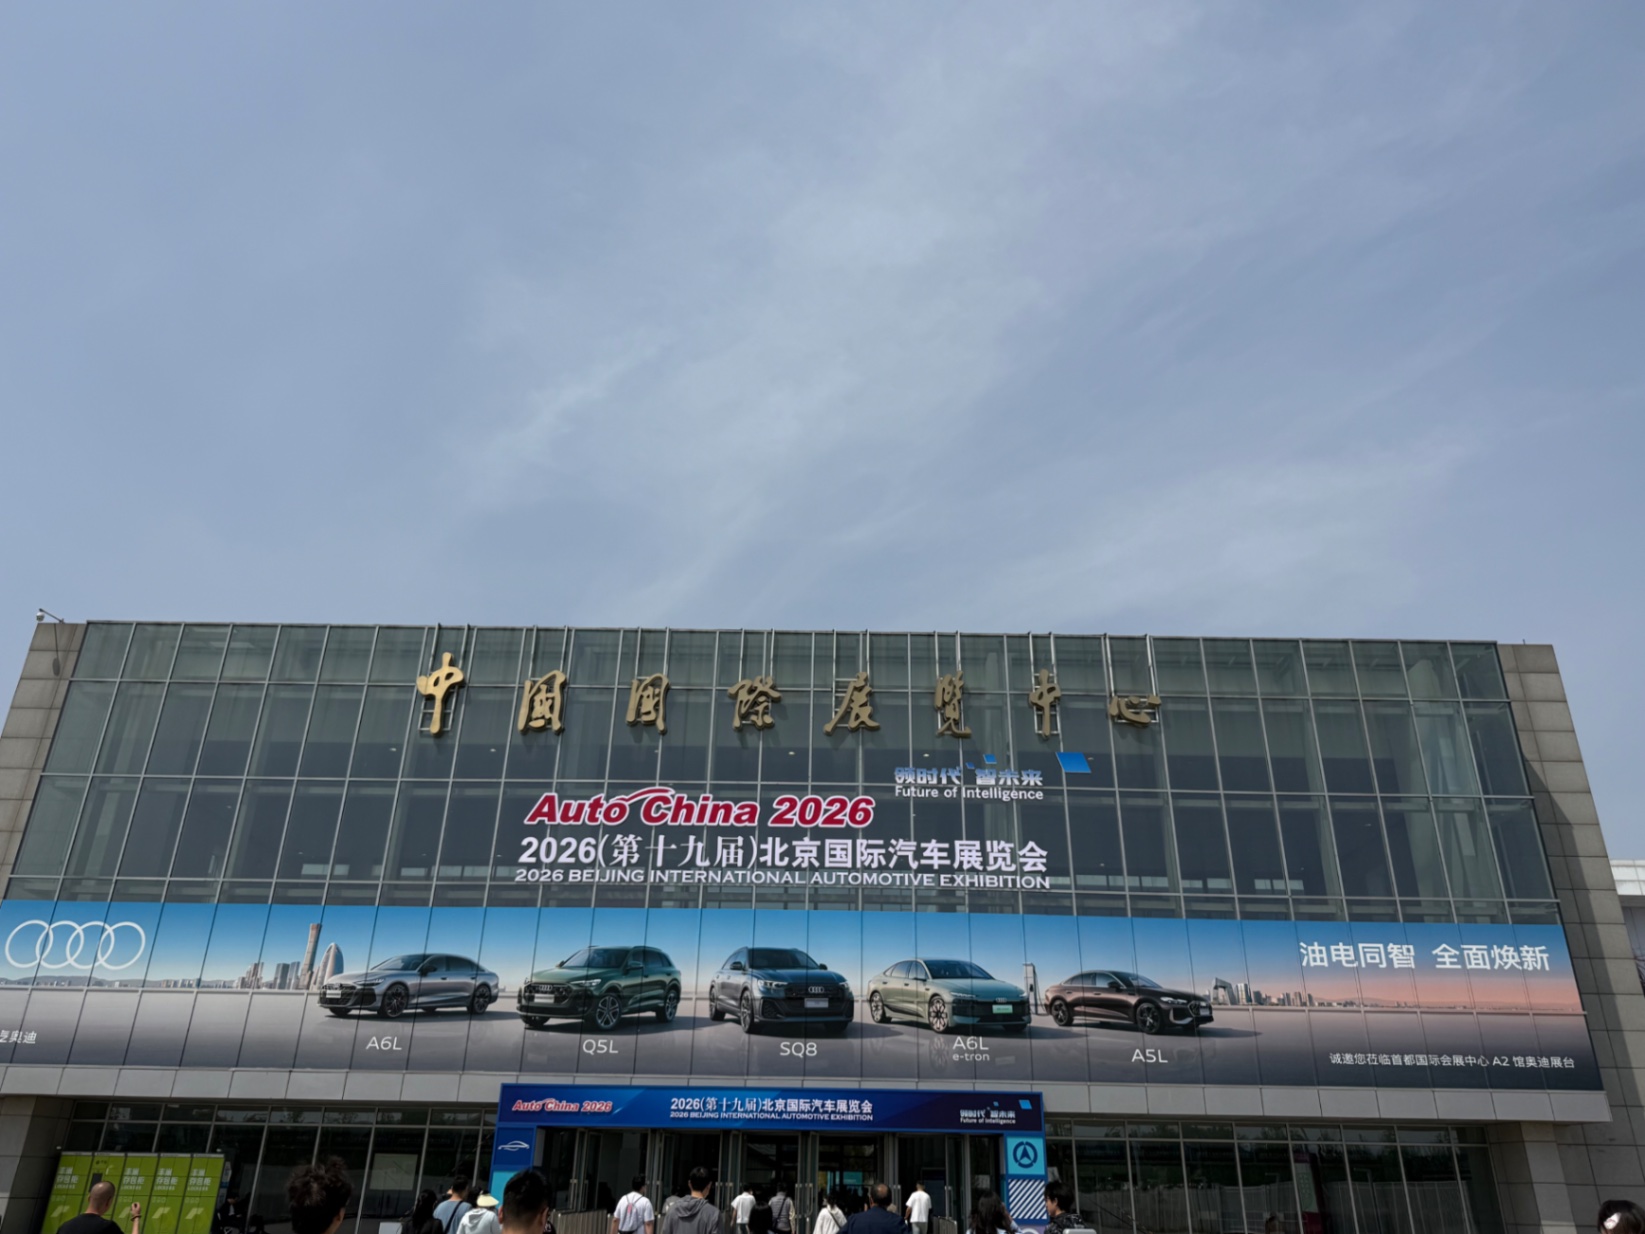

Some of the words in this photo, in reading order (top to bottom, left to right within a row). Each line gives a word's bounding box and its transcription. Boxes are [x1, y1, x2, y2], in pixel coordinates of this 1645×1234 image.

[895, 766, 962, 785] 领时代
[975, 768, 1043, 786] 智未来
[895, 785, 939, 798] Future
[944, 786, 958, 798] of
[962, 786, 1043, 802] Intelligence
[524, 793, 629, 826] Auto
[640, 791, 760, 827] China
[768, 795, 876, 828] 2026
[515, 869, 563, 883] 2026
[568, 870, 645, 883] BEIJING
[650, 869, 805, 885] INTERNATIONAL
[810, 871, 935, 887] AUTOMOTIVE
[940, 873, 1050, 889] EXHIBITION
[1300, 942, 1416, 969] 油电同智
[1432, 944, 1550, 971] 全面焕新
[366, 1036, 402, 1051] A6L
[582, 1039, 619, 1054] Q5L
[780, 1041, 818, 1057] SQ8
[952, 1036, 989, 1050] A6L
[952, 1052, 990, 1062] e-tron
[1131, 1049, 1168, 1063] A5L
[1492, 1056, 1510, 1067] A2
[512, 1100, 542, 1111] Auto
[544, 1099, 580, 1112] China
[581, 1101, 613, 1112] 2026
[690, 1111, 719, 1119] BEIJING
[720, 1112, 780, 1120] INTERNATIONAL
[781, 1112, 830, 1121] AUTOMOTIVE
[830, 1114, 873, 1122] EXHIBITION
